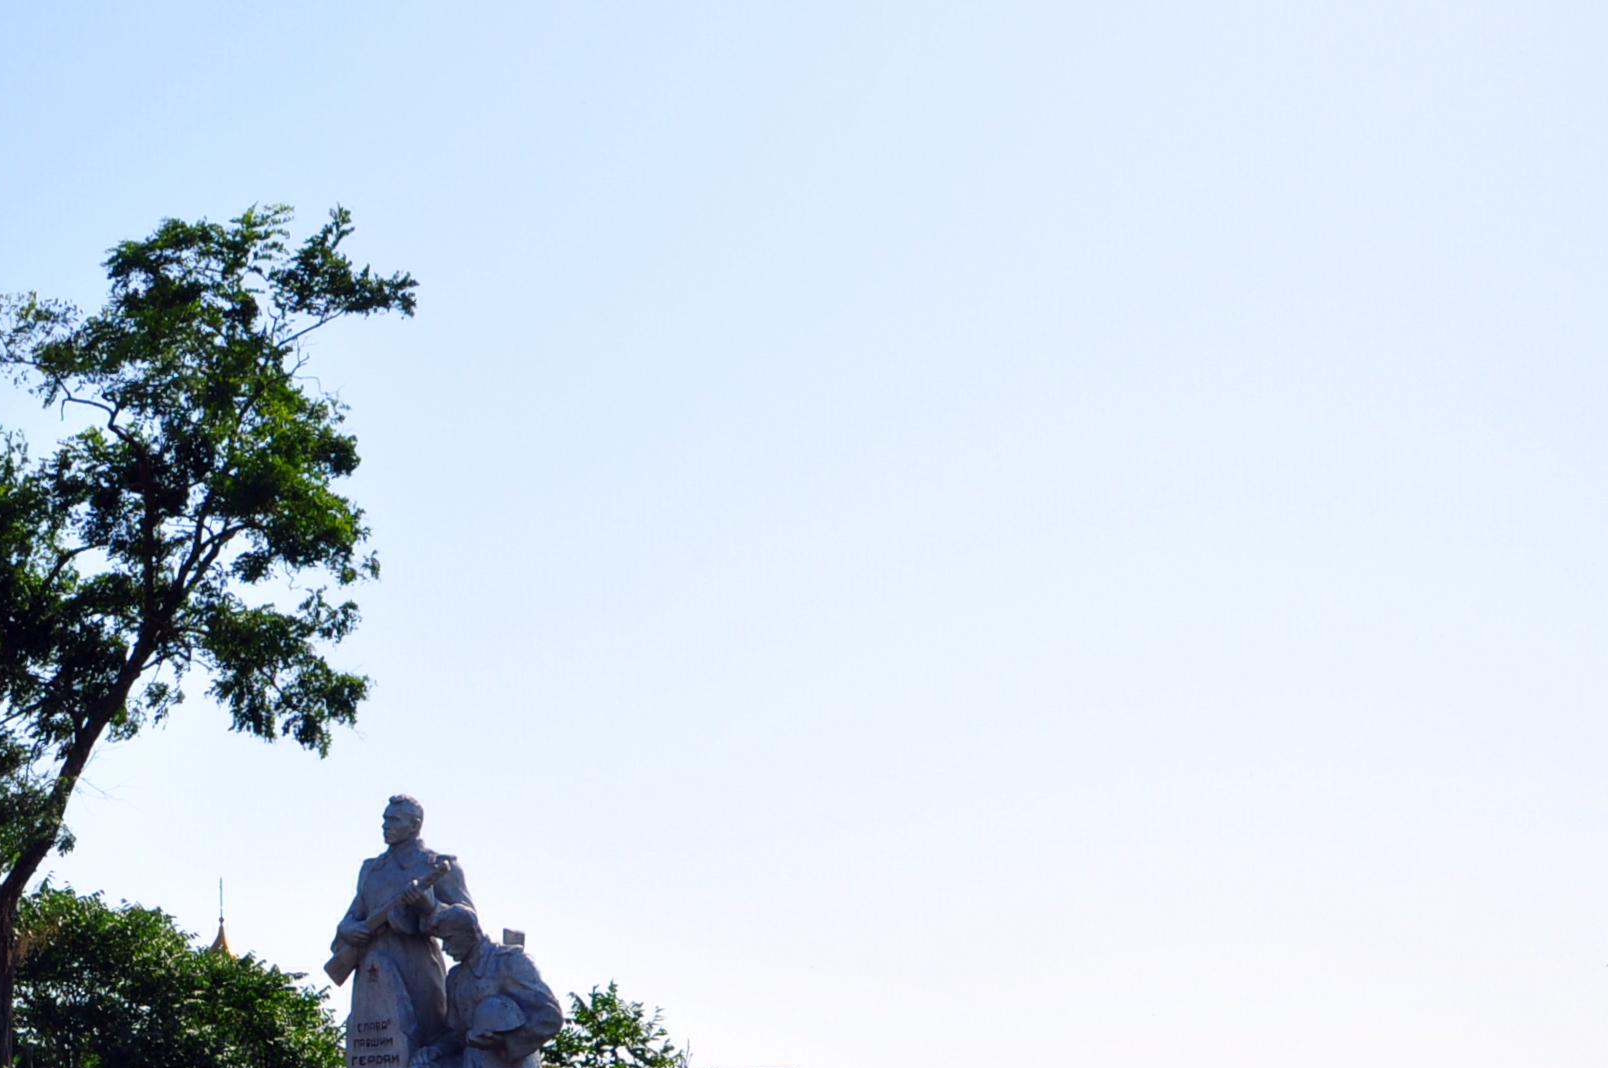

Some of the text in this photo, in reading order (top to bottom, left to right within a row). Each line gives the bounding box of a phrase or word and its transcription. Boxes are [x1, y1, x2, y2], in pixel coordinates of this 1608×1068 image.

[357, 1021, 388, 1033] СЛАВА
[353, 1037, 394, 1048] ПАВШИМ
[351, 1054, 400, 1067] ГЕРОЯМ
